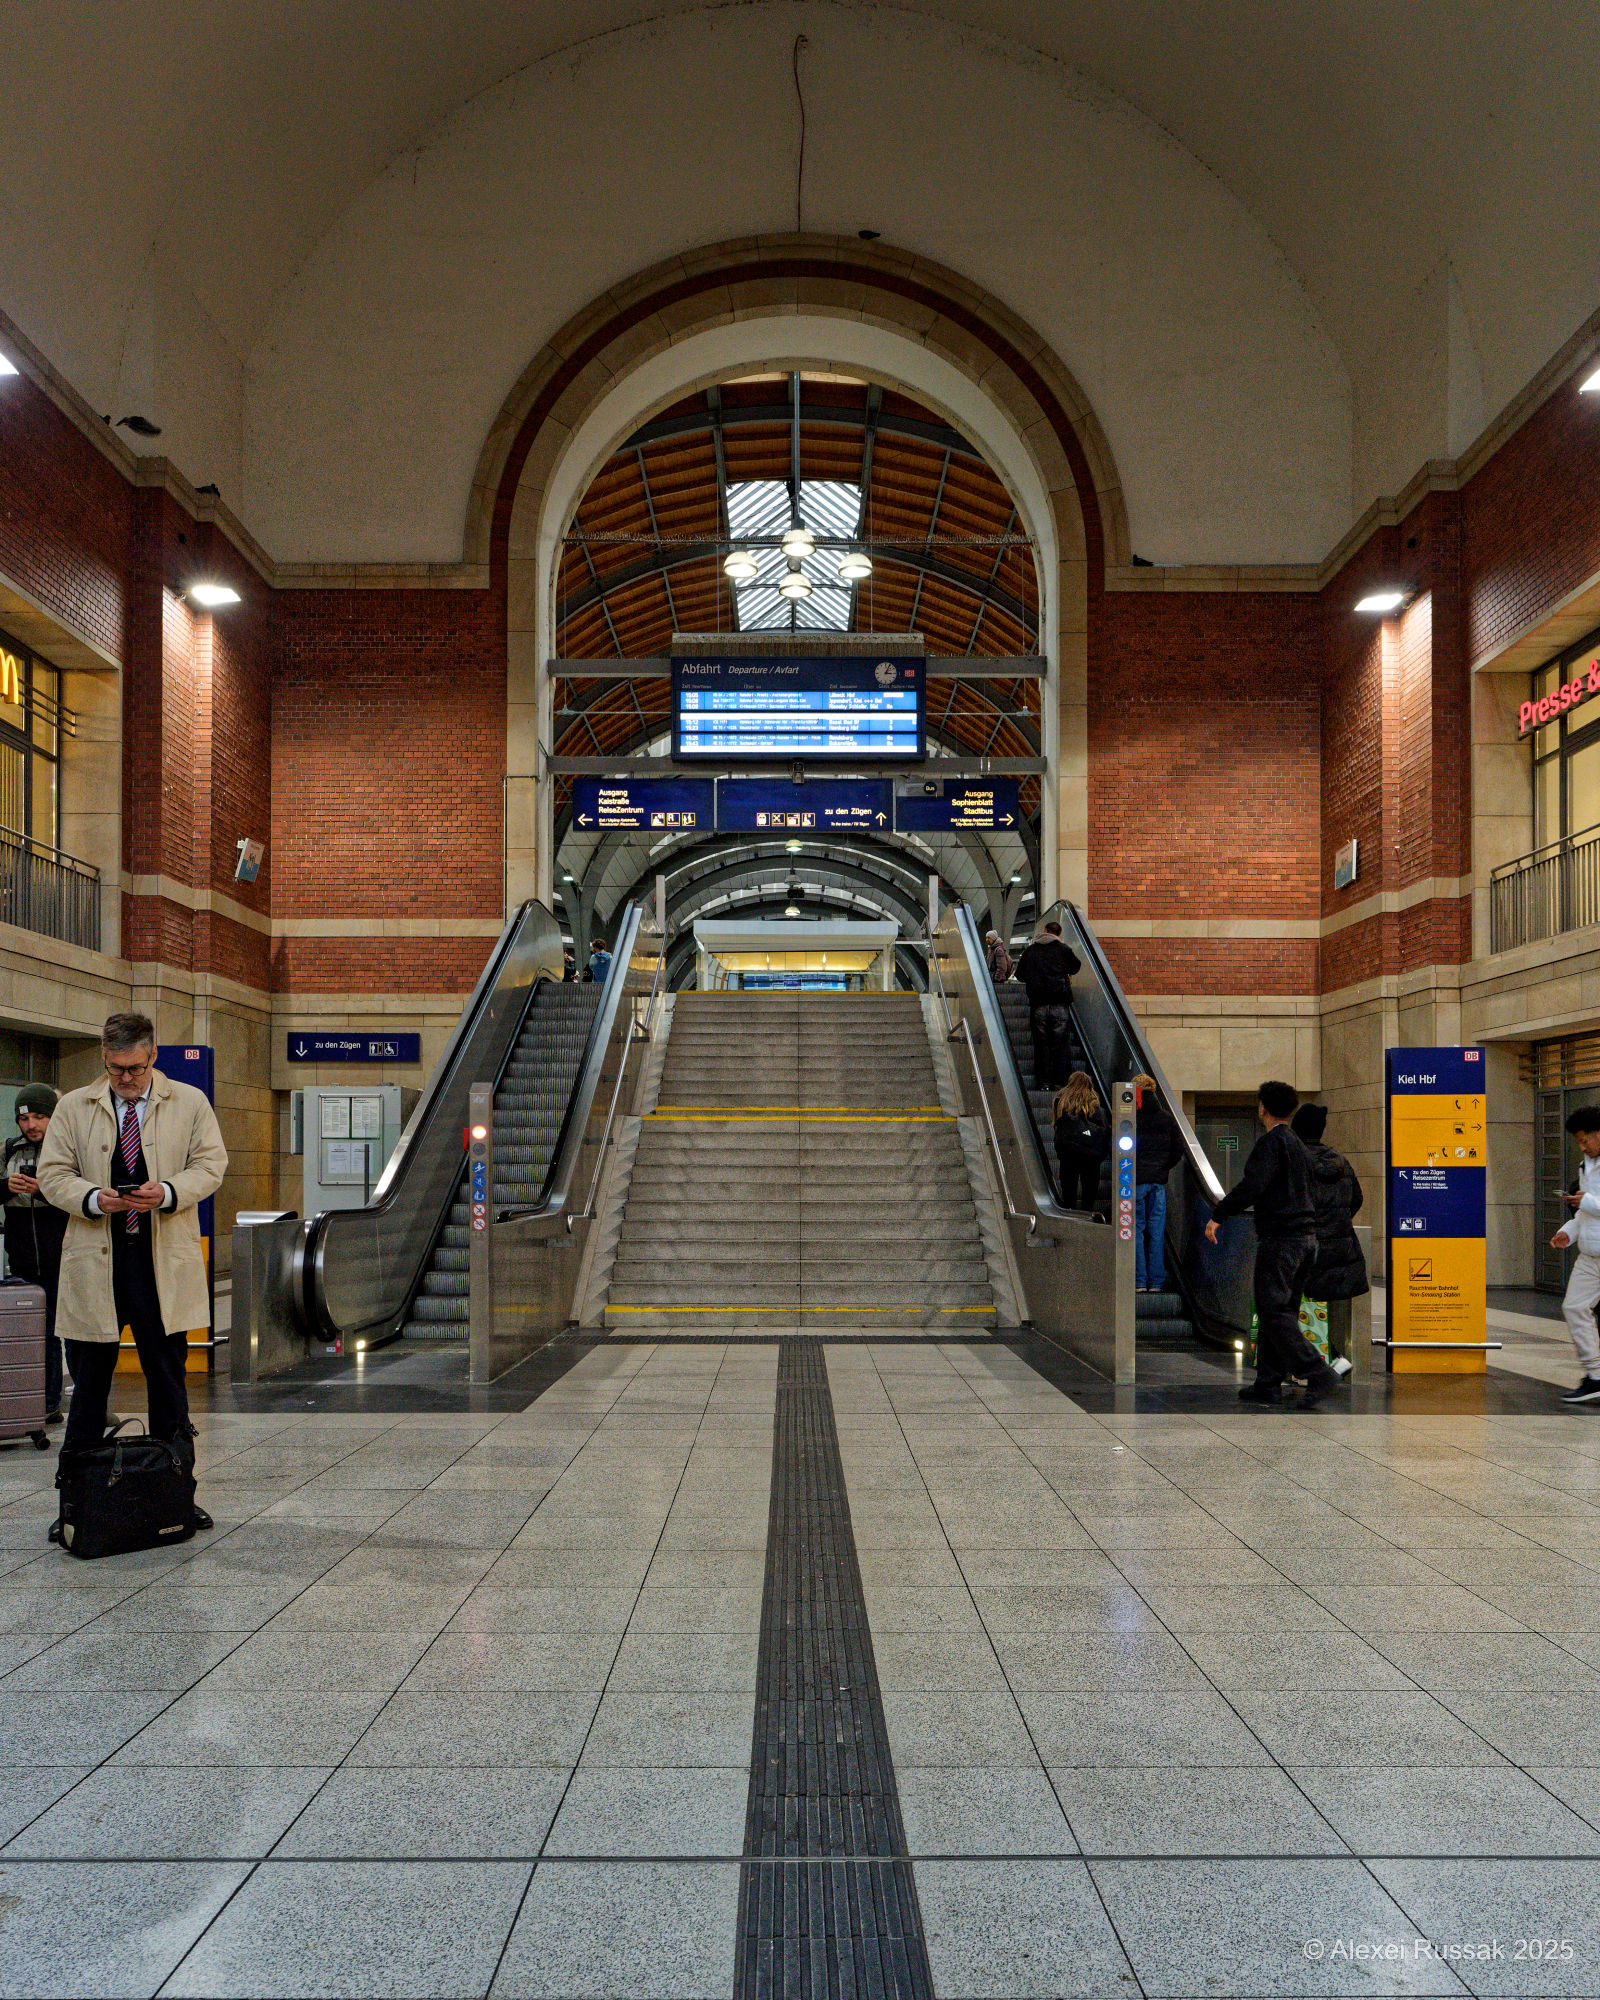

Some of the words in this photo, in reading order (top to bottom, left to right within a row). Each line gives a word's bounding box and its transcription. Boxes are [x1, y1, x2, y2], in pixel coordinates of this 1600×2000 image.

[682, 664, 721, 674] Abfahrt
[728, 666, 768, 676] Departure
[769, 666, 774, 674] /
[774, 666, 799, 674] Avfart
[1520, 678, 1582, 732] Presse
[599, 789, 628, 797] Ausgang
[952, 799, 993, 807] Sophienblatt
[851, 808, 872, 816] Zügen
[339, 1041, 361, 1050] Zügen
[186, 1050, 199, 1059] DB
[1398, 1075, 1416, 1084] Kiel
[1419, 1075, 1436, 1084] Hbf
